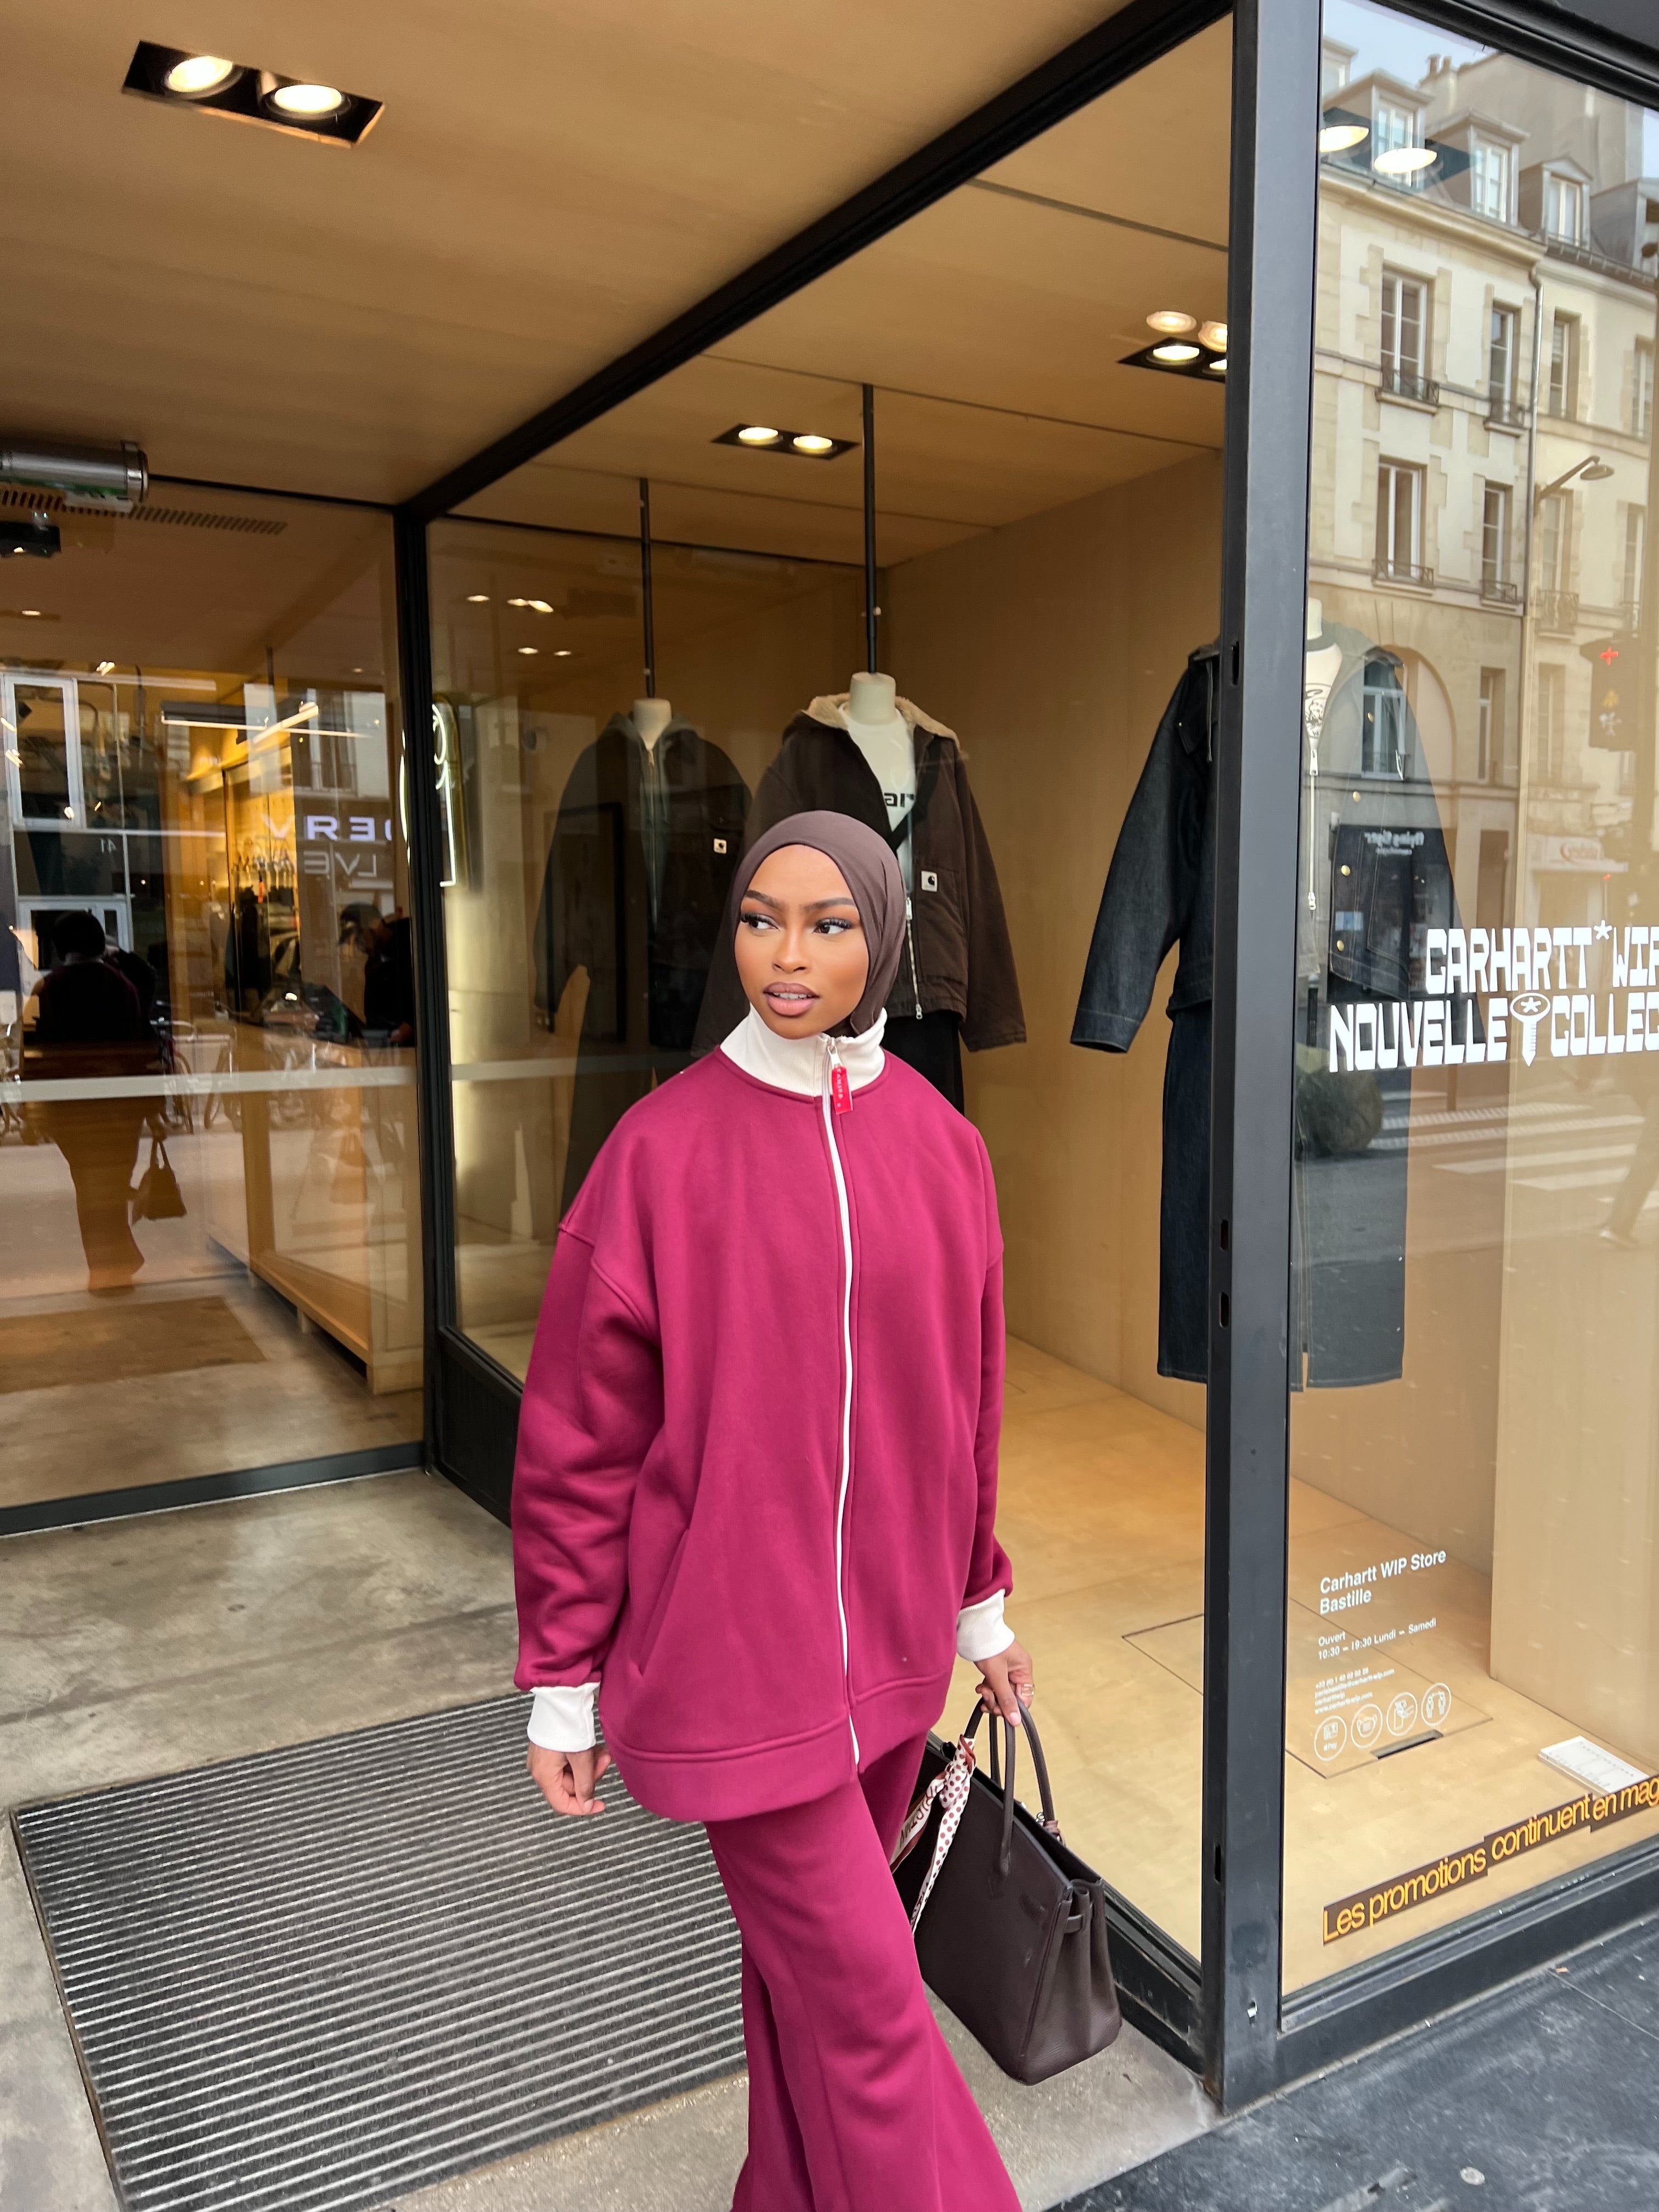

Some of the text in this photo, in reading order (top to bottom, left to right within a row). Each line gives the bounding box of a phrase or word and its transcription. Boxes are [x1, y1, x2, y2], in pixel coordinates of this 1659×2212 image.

[1426, 927, 1592, 995] CARHARTT
[1329, 997, 1508, 1073] NOUVELLE
[1320, 1550, 1447, 1594] Carhartt WIP Store
[1320, 1588, 1372, 1615] Bastille
[1318, 1630, 1346, 1646] Ouvert
[1318, 1646, 1340, 1660] 10:30
[1351, 1637, 1372, 1651] 19:30
[1374, 1629, 1396, 1644] Lundi
[1408, 1617, 1436, 1634] Samedi
[1324, 1901, 1365, 1942] Les
[1369, 1848, 1486, 1928] promotions
[1491, 1792, 1590, 1861] continuent
[1593, 1793, 1617, 1821] en
